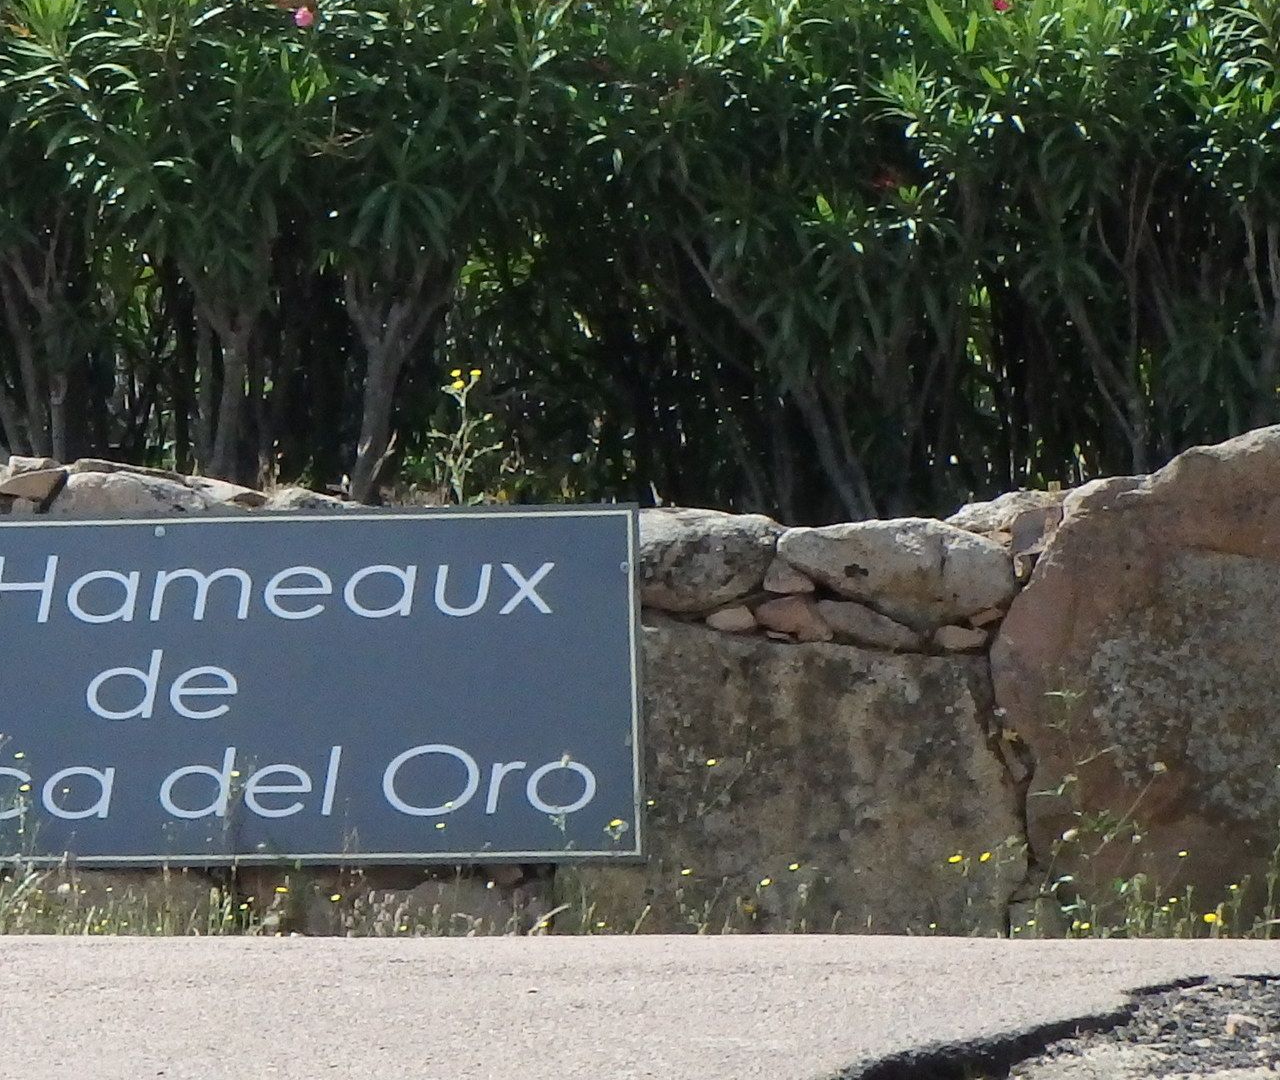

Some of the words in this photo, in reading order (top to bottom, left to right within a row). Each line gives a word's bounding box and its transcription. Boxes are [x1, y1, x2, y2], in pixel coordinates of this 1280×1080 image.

[85, 649, 239, 720] de
[159, 745, 344, 817] del
[382, 743, 597, 817] Oro
